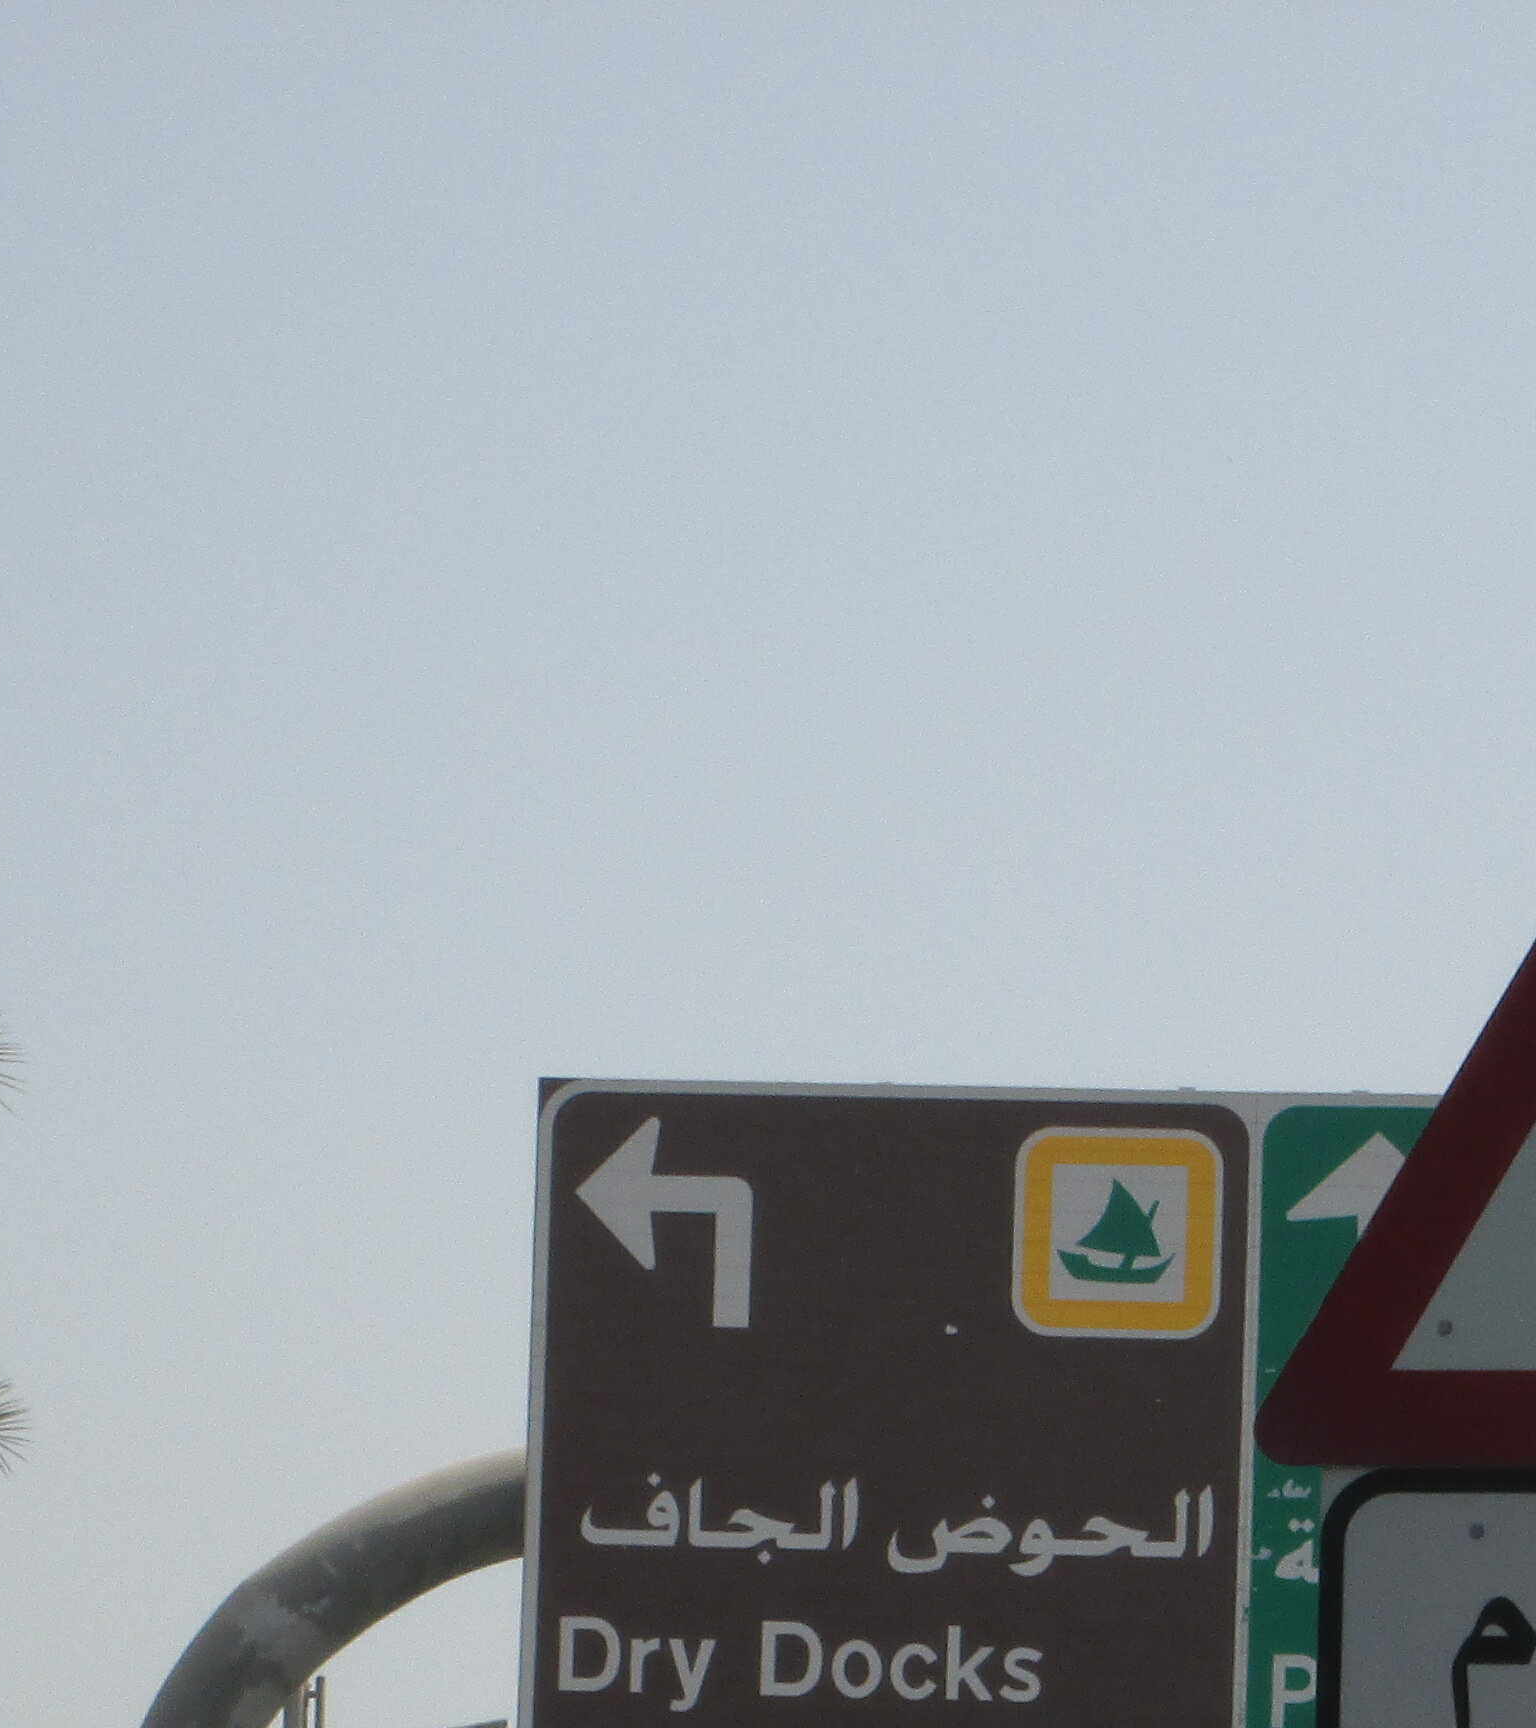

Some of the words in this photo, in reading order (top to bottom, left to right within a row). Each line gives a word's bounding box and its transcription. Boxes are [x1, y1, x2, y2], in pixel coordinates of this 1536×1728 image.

[580, 1473, 859, 1565] الجاف
[887, 1485, 1214, 1577] الحوض
[557, 1615, 717, 1712] Dry
[759, 1620, 1043, 1702] Docks
